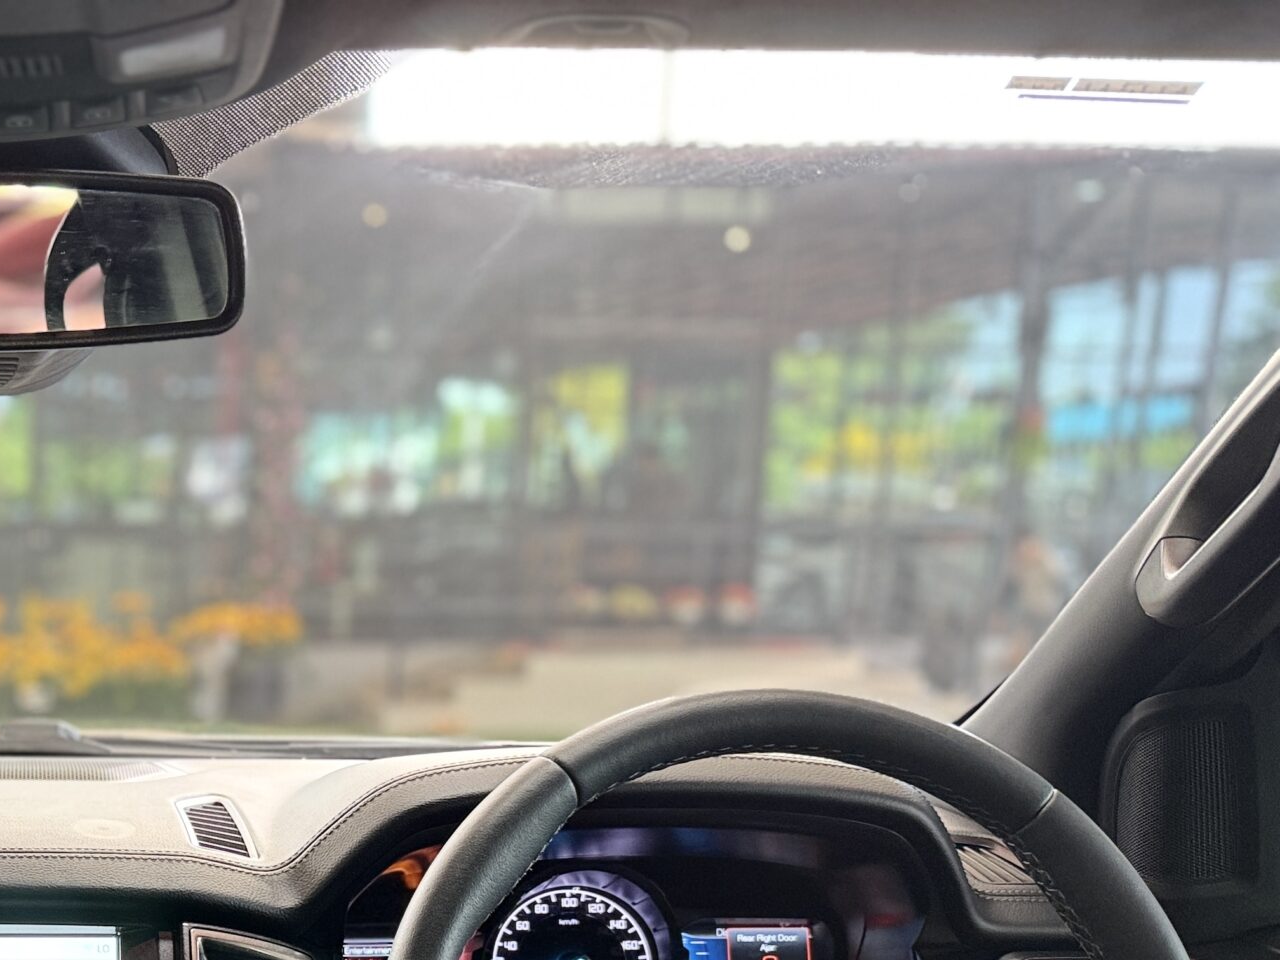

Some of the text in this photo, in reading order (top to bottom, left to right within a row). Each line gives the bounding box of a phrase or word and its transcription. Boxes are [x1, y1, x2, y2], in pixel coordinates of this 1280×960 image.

[561, 897, 579, 907] 100
[534, 904, 549, 914] 80
[587, 903, 606, 914] 120
[515, 920, 530, 931] 60
[558, 918, 580, 926] km/h
[609, 919, 628, 930] 140
[737, 934, 798, 943] Rear Right Door
[97, 944, 110, 954] LO
[503, 940, 518, 951] 40
[622, 941, 639, 951] 160
